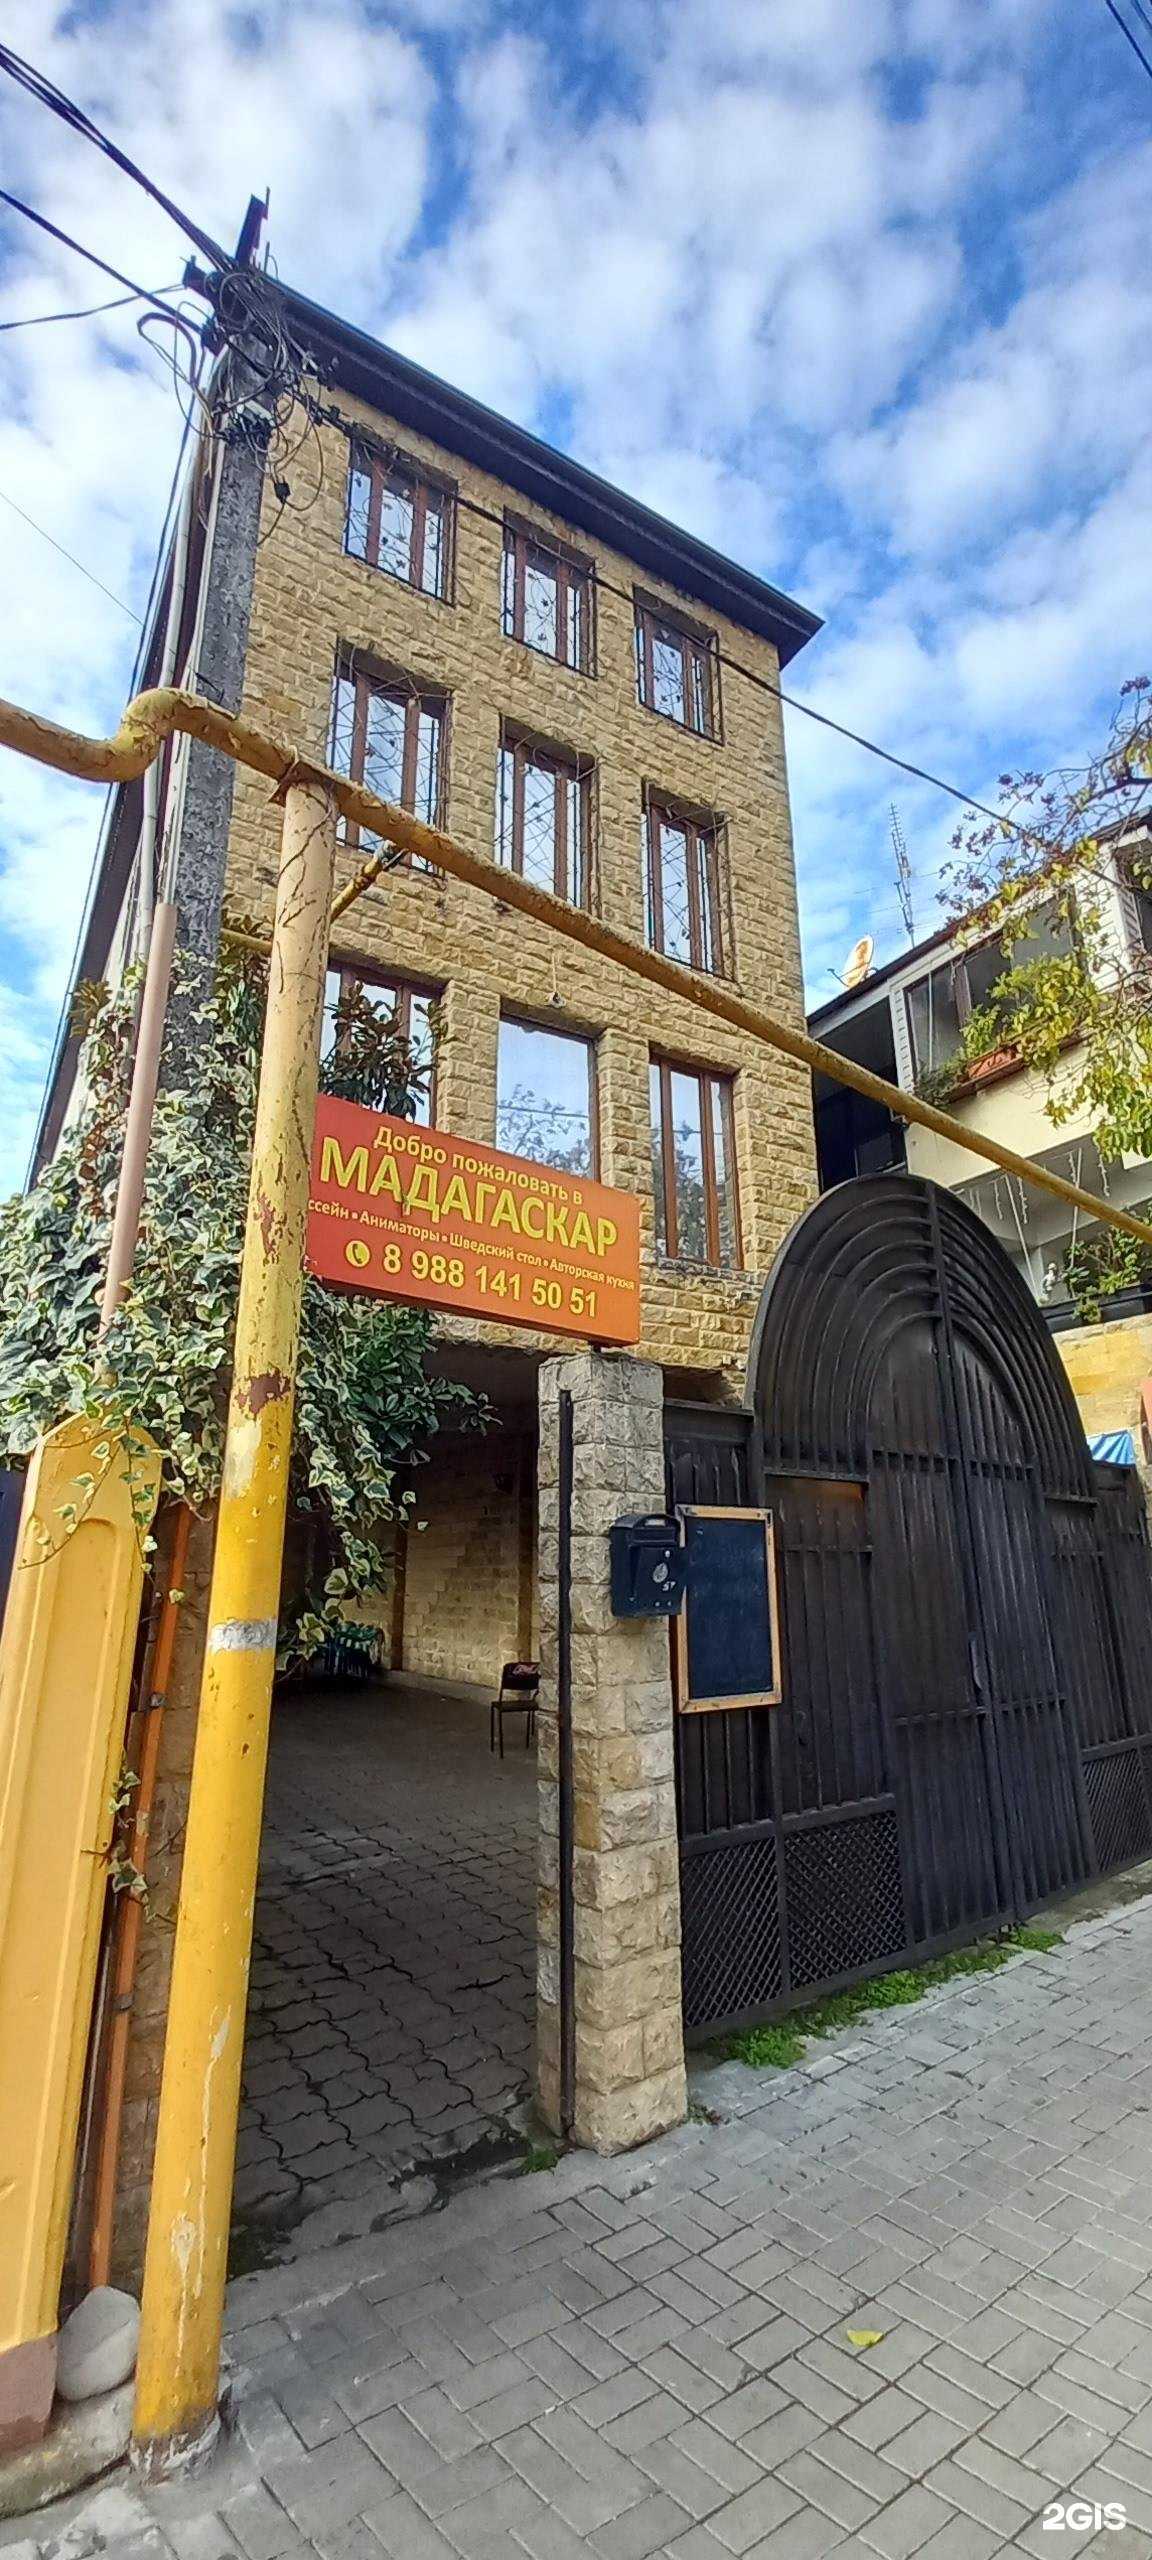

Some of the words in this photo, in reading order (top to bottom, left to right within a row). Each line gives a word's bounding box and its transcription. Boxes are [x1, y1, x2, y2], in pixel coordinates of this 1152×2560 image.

[320, 1136, 618, 1257] МАДАГАСКАР
[373, 1126, 447, 1164] Добро
[452, 1153, 568, 1201] пожаловать
[573, 1190, 583, 1205] в
[308, 1200, 349, 1219] ссейн
[359, 1211, 440, 1242] Аниматоры
[450, 1232, 514, 1260] Шведский
[516, 1251, 543, 1267] стол
[549, 1258, 605, 1283] Авторская
[606, 1275, 636, 1292] кухня
[382, 1243, 402, 1274] 8
[411, 1250, 465, 1288] 988
[475, 1265, 522, 1301] 141
[531, 1278, 563, 1309] 50
[569, 1287, 597, 1318] 51
